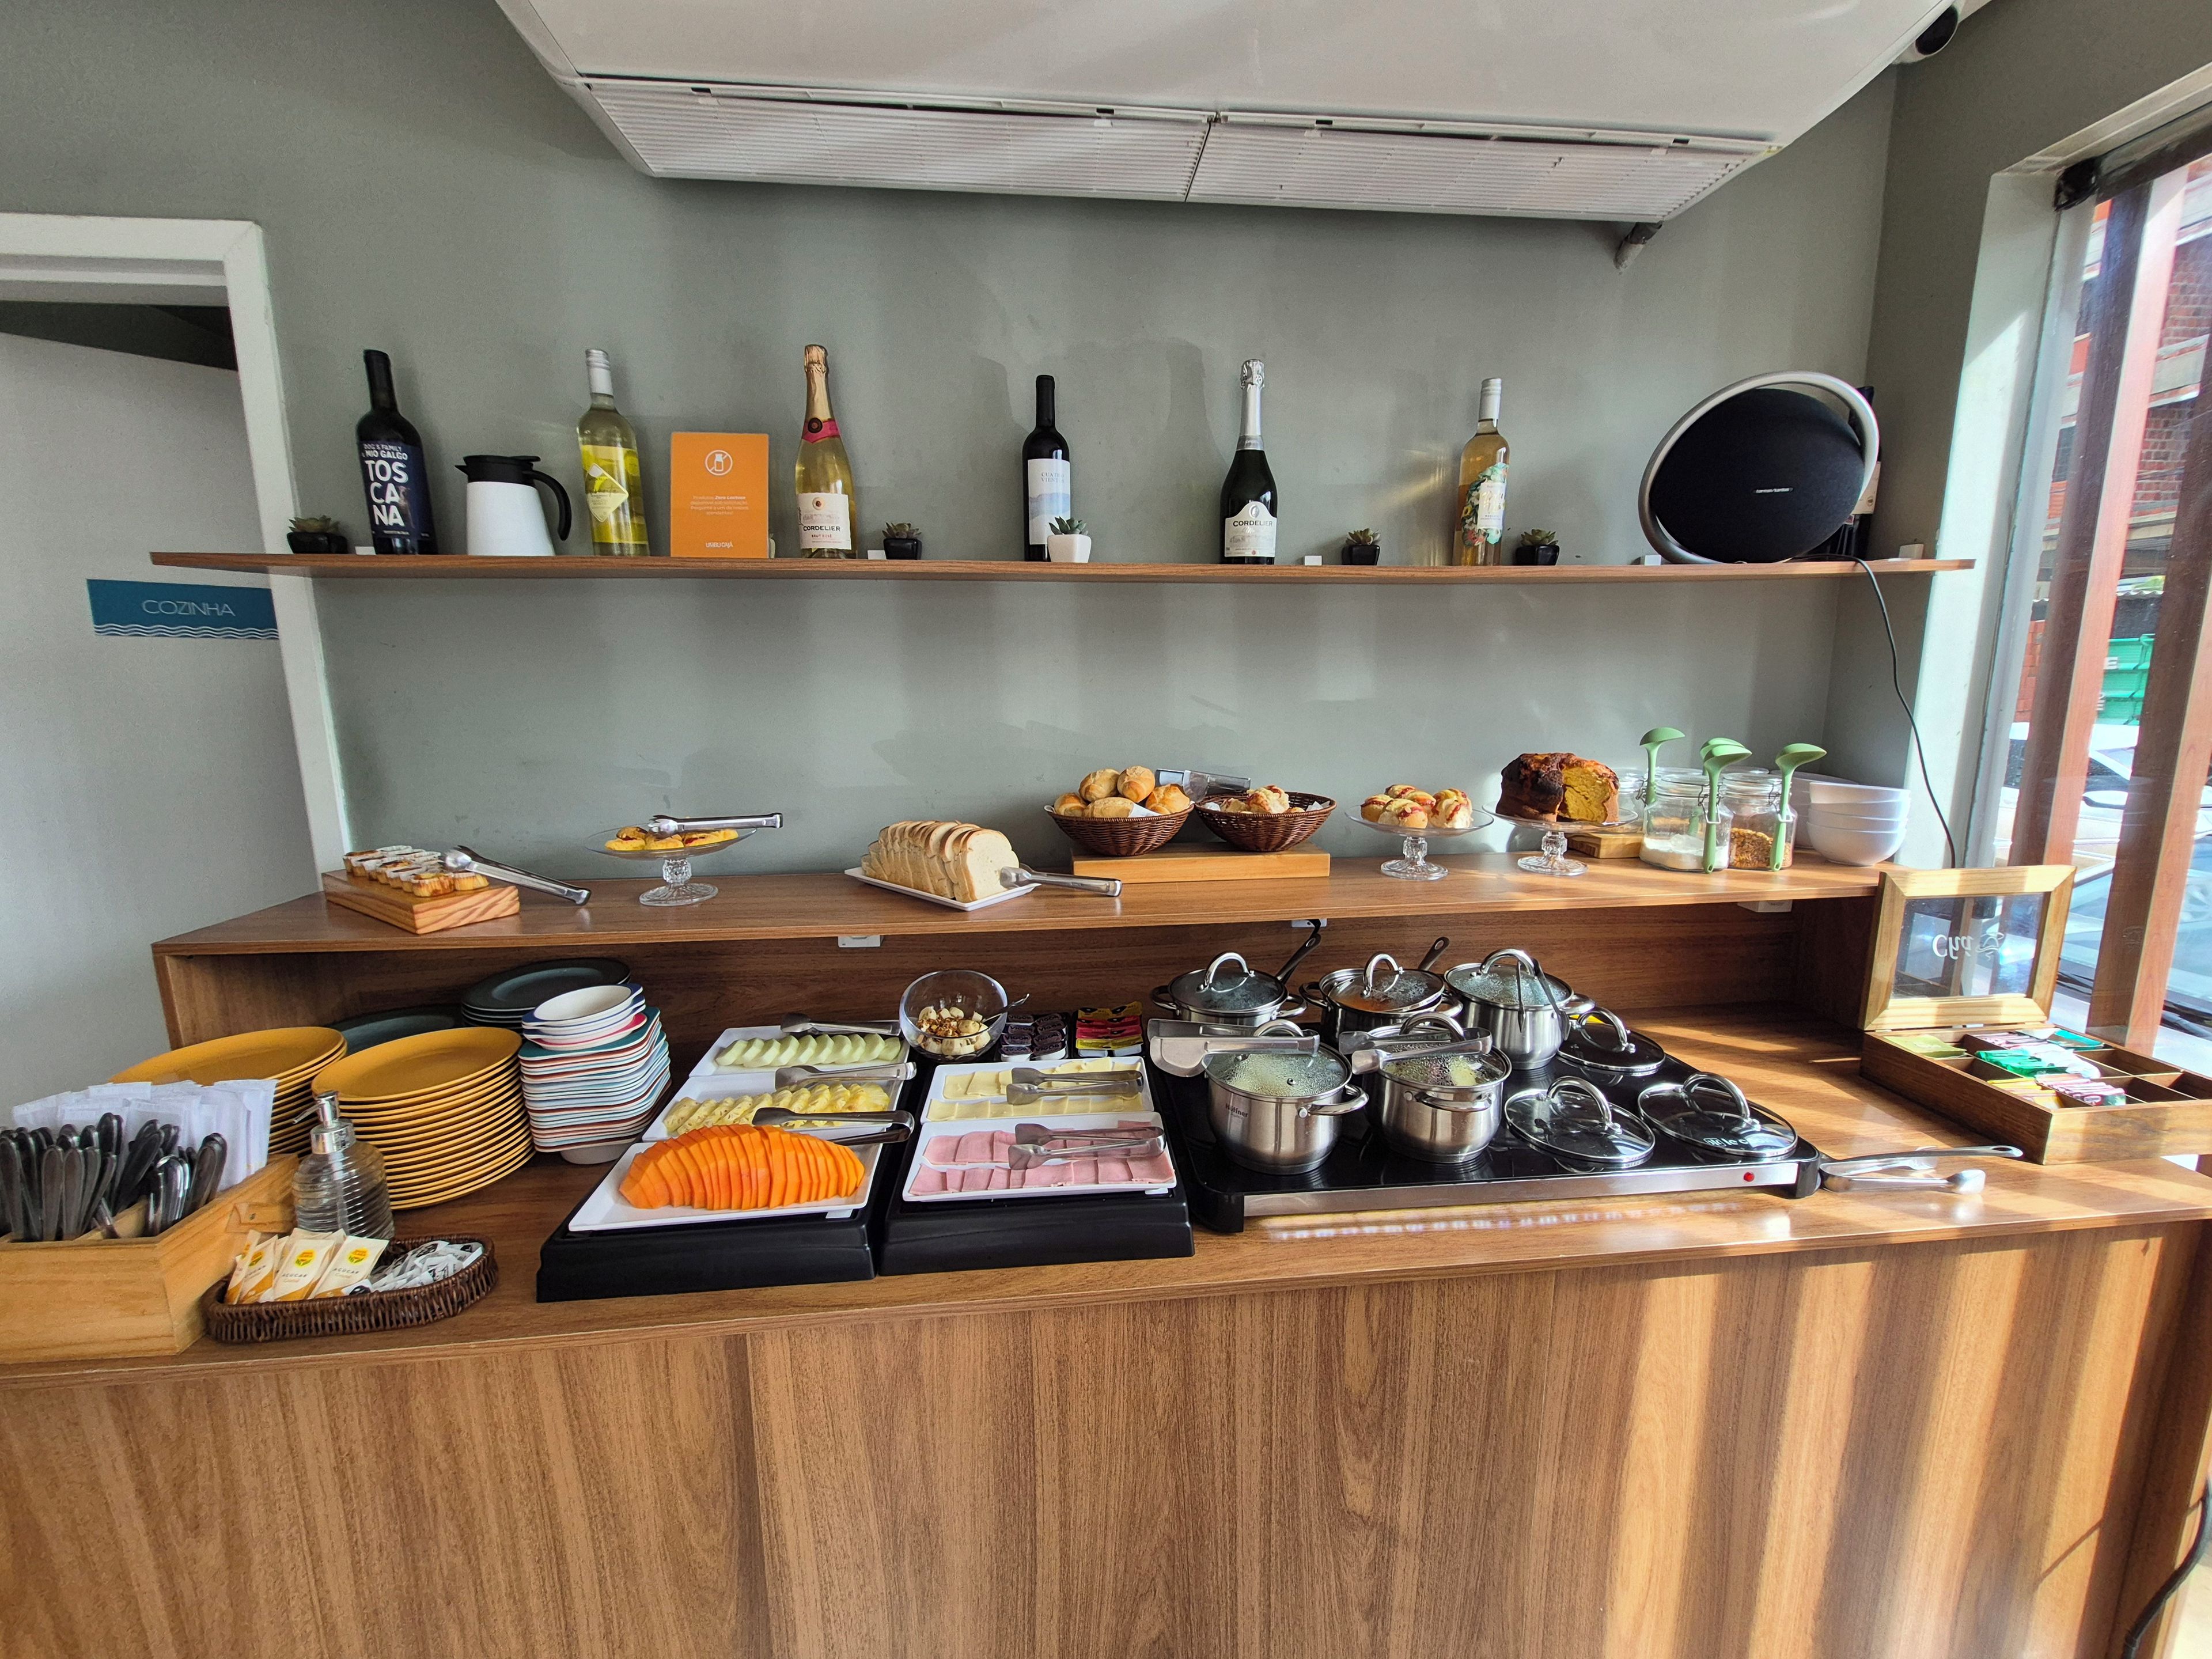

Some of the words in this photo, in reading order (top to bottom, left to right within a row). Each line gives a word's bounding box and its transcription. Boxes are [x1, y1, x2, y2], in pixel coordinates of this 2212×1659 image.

[380, 450, 408, 460] GALGO
[365, 460, 408, 483] TOS
[370, 482, 400, 504] CA
[373, 505, 405, 527] NA
[142, 600, 236, 617] COZINHA
